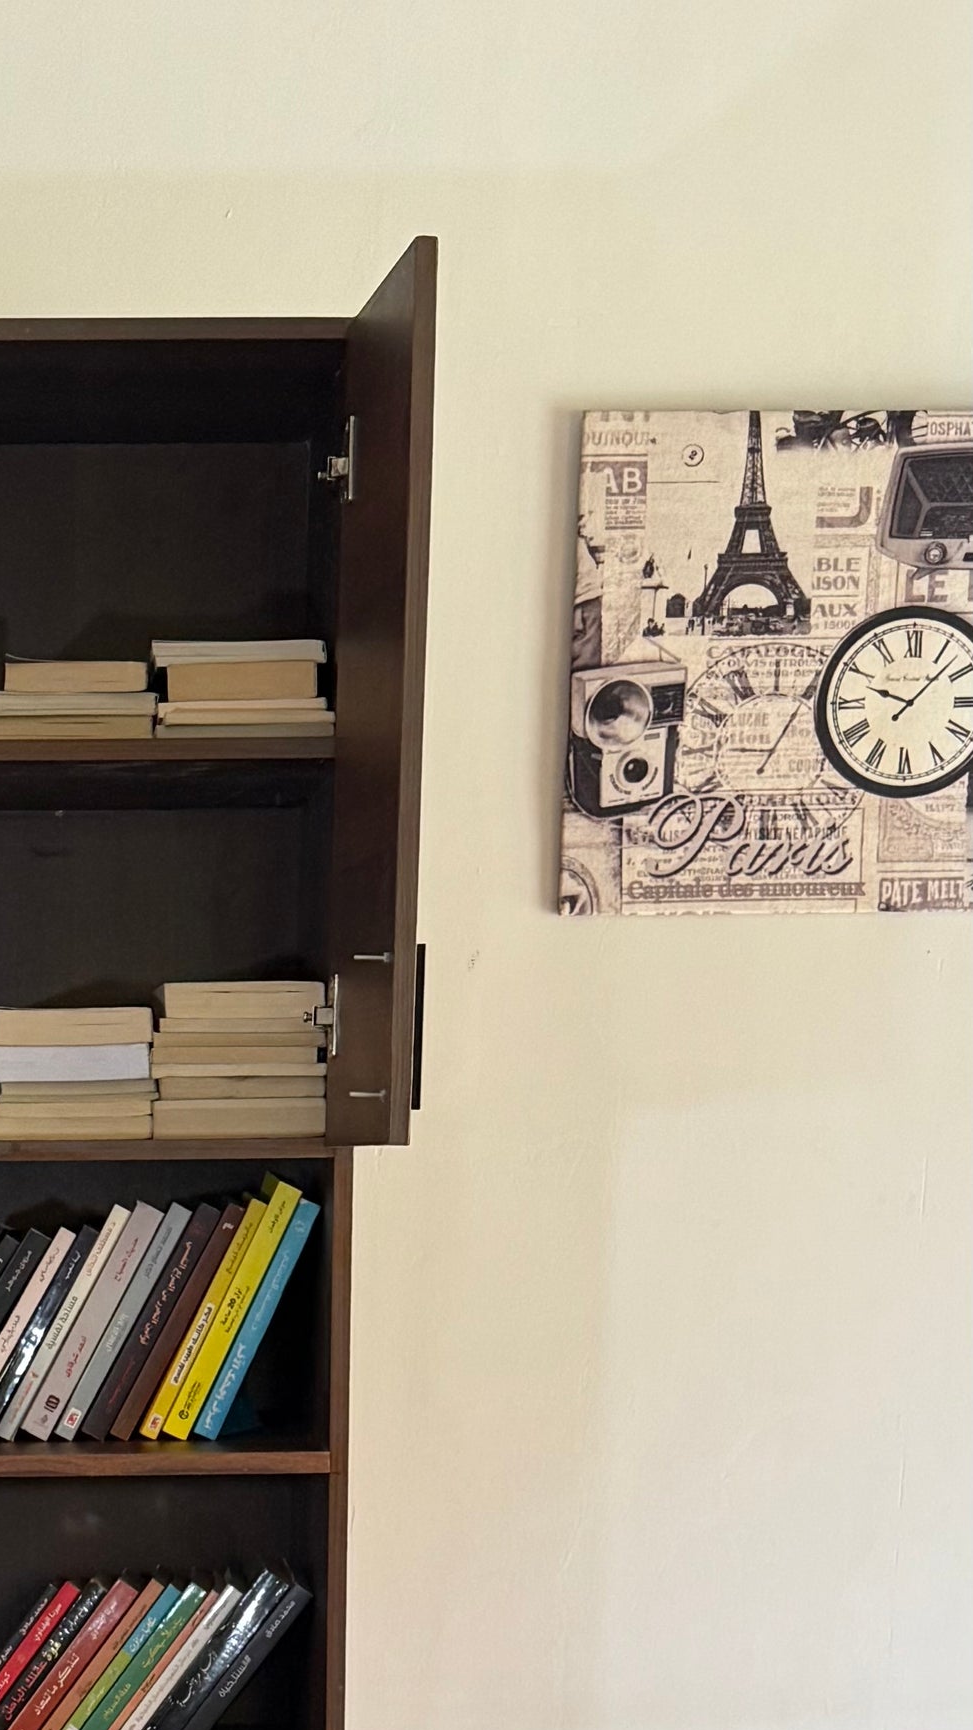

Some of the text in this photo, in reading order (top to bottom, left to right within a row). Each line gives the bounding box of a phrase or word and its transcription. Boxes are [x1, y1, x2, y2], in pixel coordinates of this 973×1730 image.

[813, 557, 861, 572] BLE
[648, 792, 854, 877] Paris
[627, 876, 866, 900] Capitale des amoureux
[58, 1294, 79, 1323] مساحة
[226, 1296, 237, 1309] 20
[44, 1322, 65, 1350] نفسية
[262, 1599, 296, 1639] محمد صادق
[21, 1656, 48, 1689] عقلك
